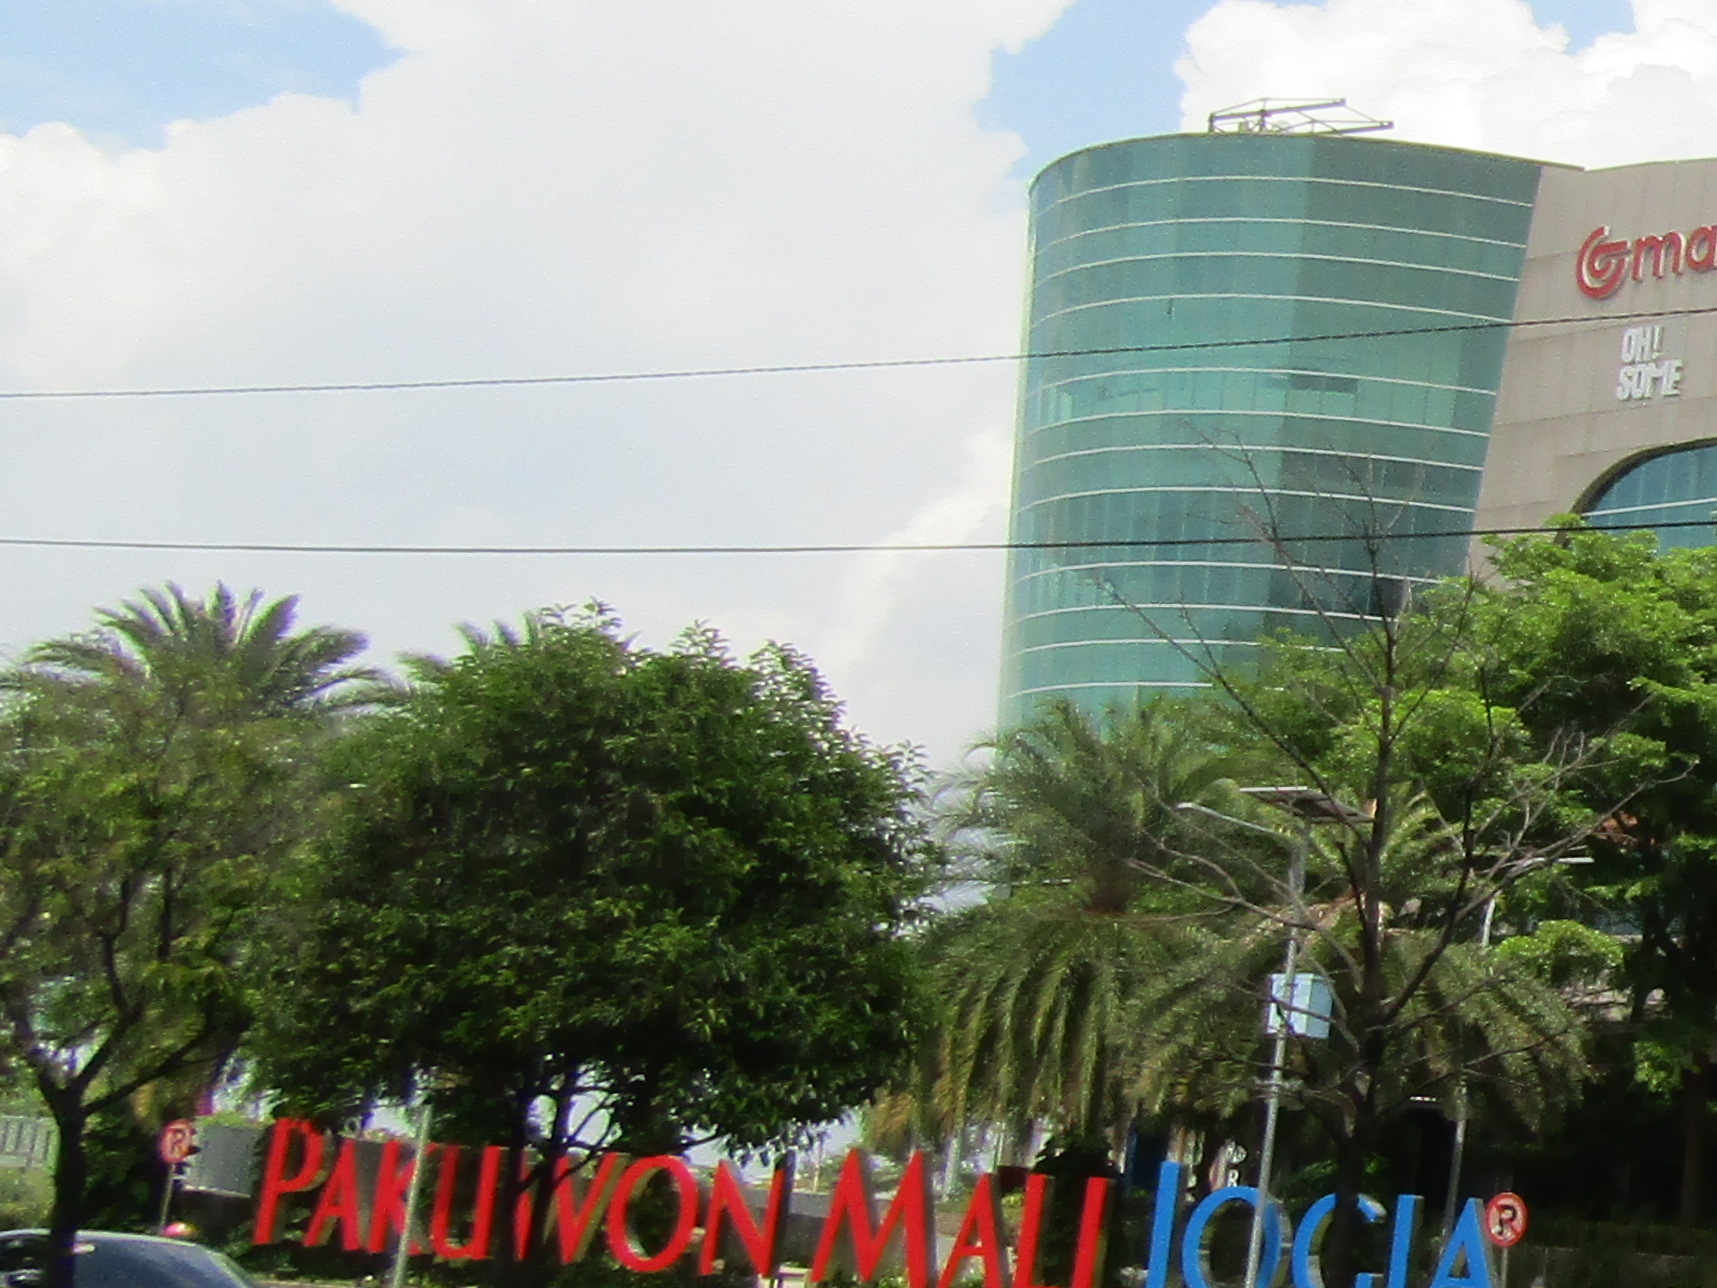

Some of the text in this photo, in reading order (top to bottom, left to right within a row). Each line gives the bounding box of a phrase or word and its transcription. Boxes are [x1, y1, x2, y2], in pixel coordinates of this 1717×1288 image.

[1620, 324, 1665, 364] OH!
[1615, 358, 1687, 401] SOME
[252, 1116, 785, 1279] PAKUWON
